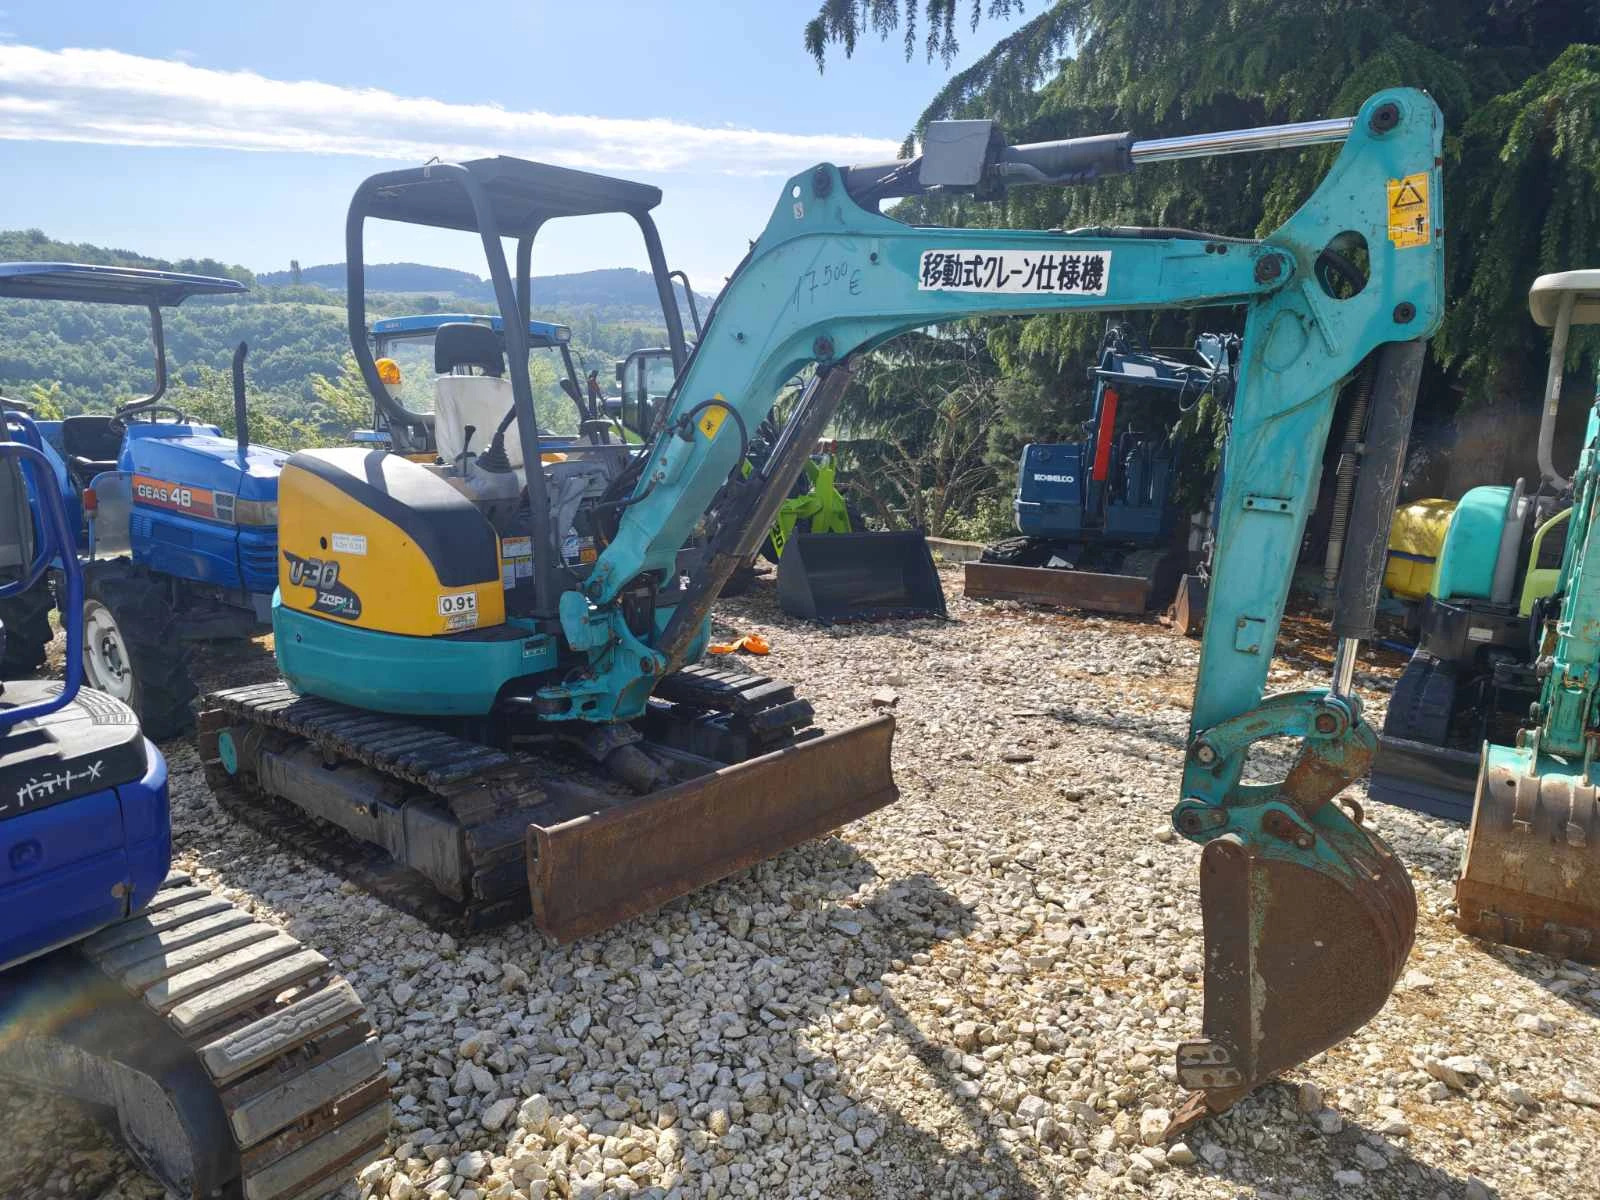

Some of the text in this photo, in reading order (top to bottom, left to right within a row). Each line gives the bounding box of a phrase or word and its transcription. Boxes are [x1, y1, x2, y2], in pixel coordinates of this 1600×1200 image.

[922, 252, 1105, 291] 移動式クレーン仕様機
[1034, 473, 1075, 484] KOBELCO
[137, 484, 193, 508] GEAS 48
[288, 558, 340, 590] U-30
